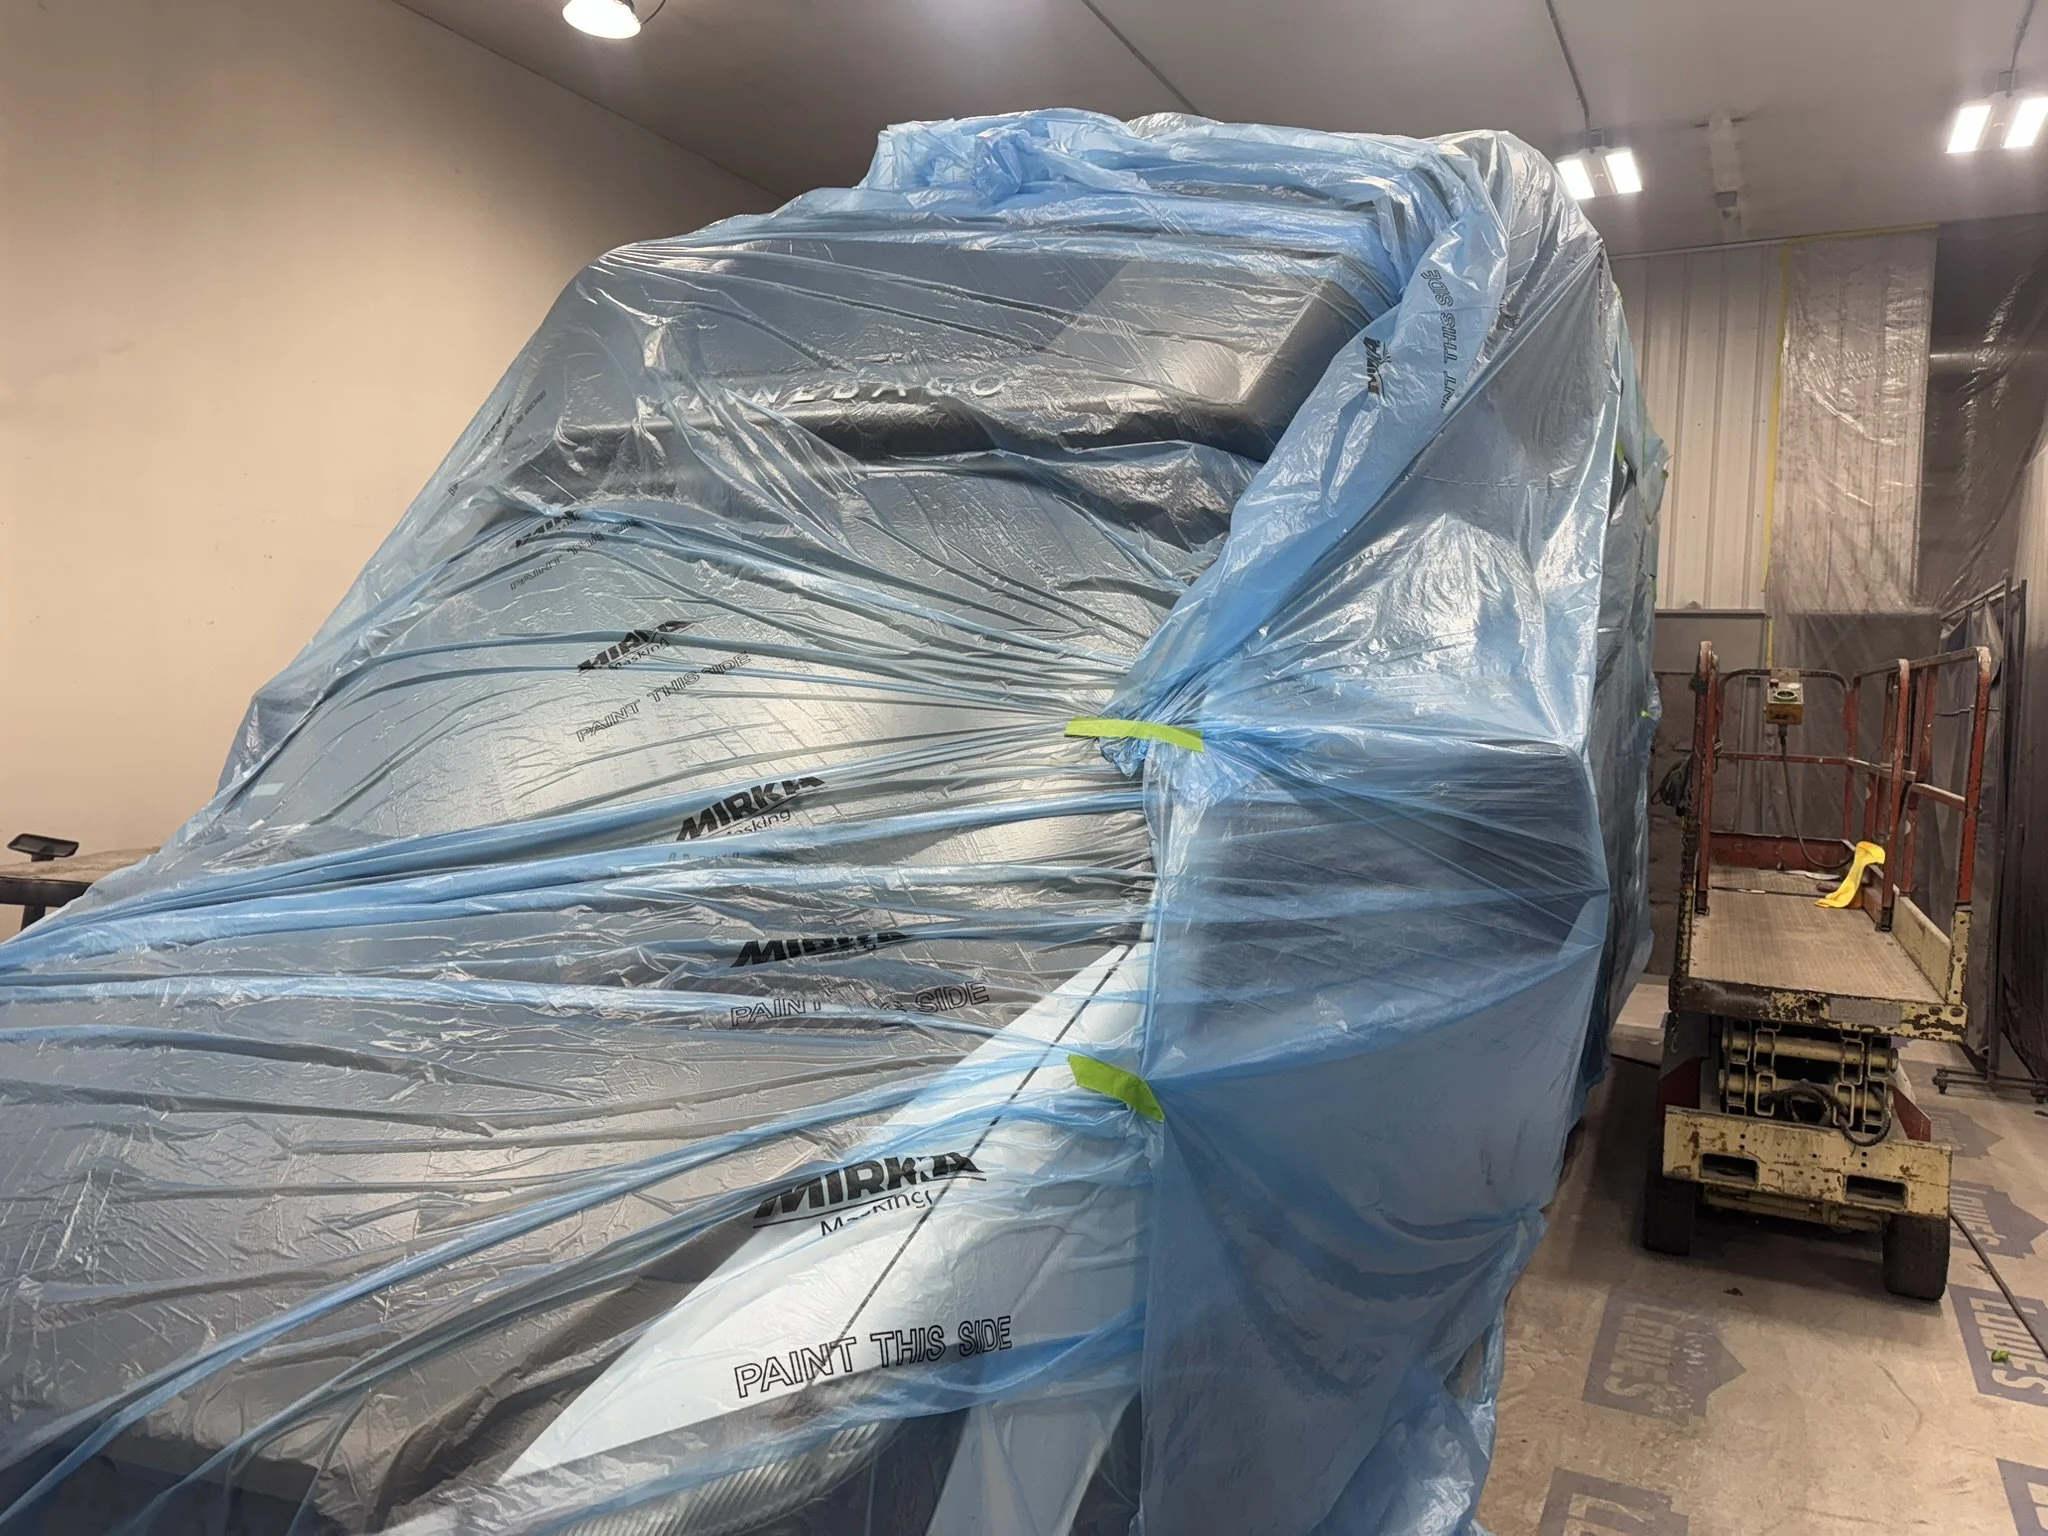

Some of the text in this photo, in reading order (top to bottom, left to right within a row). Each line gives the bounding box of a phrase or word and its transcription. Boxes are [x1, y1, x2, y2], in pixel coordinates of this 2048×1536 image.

[1421, 270, 1453, 306] SIDE
[1440, 313, 1457, 364] THIS
[576, 699, 640, 743] PAINT
[647, 671, 700, 702] THIS
[726, 809, 791, 836] sking
[915, 980, 991, 1013] SIDE
[753, 1151, 985, 1220] MIRKA
[820, 1189, 933, 1236] Mking
[734, 1315, 1013, 1399] PAINT THIS SIDE
